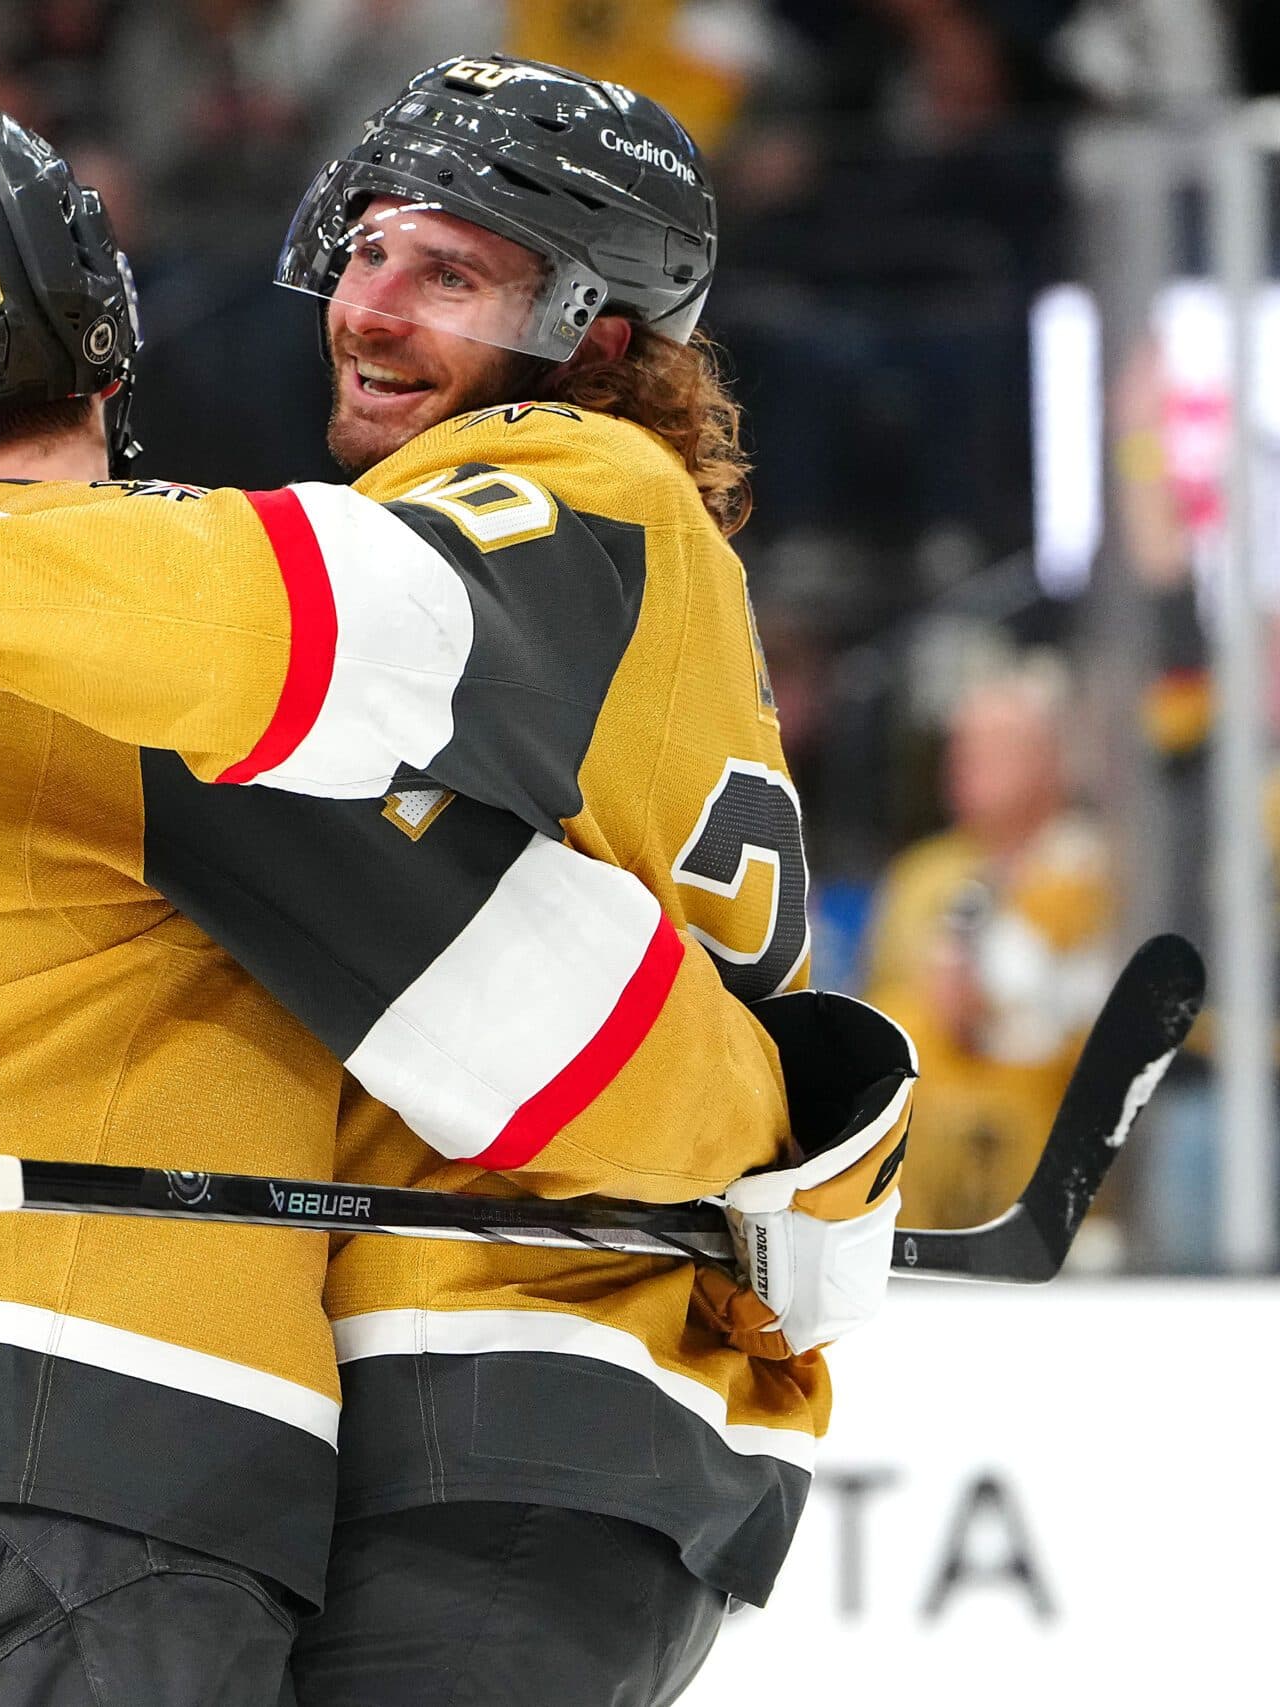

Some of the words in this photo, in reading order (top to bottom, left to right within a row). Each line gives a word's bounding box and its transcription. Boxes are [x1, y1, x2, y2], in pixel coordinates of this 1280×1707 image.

[599, 127, 696, 187] CreditOne
[287, 1192, 372, 1218] BAUER
[755, 1224, 769, 1300] DOROFEYEV
